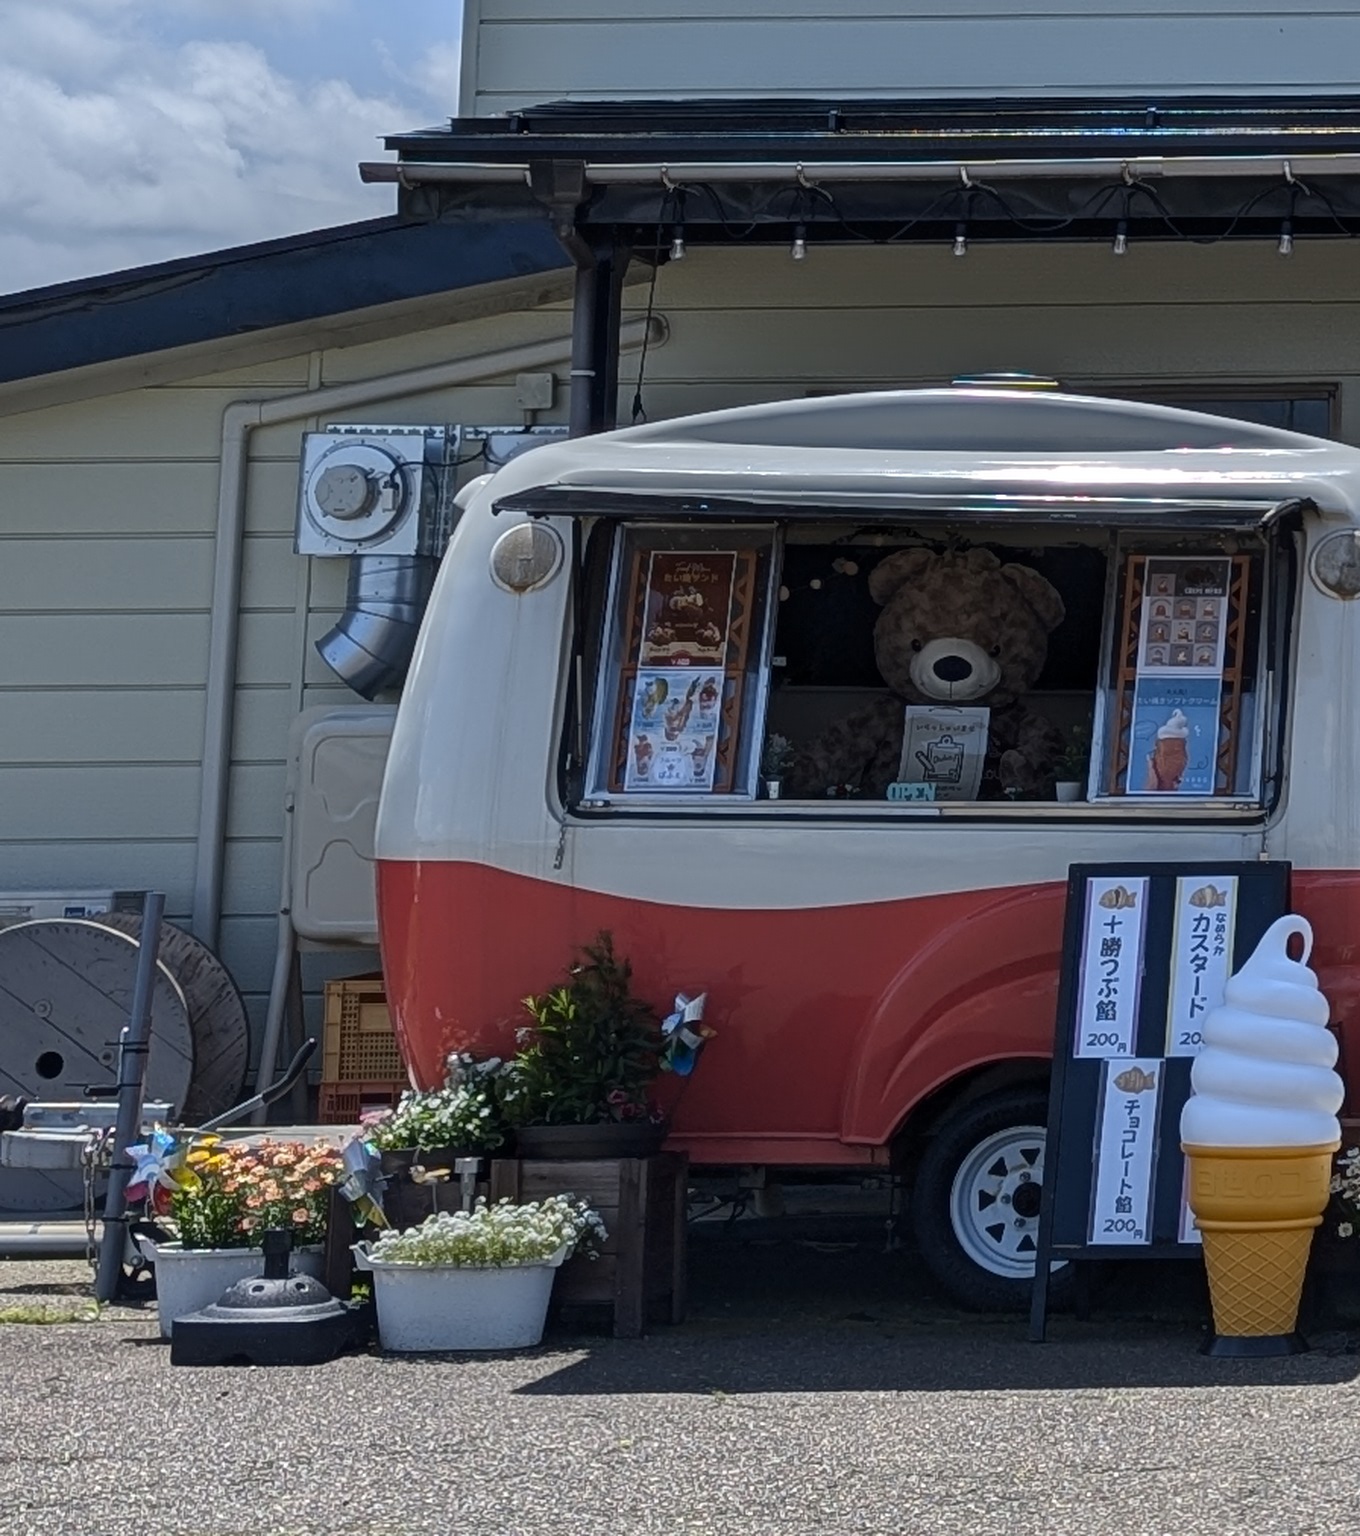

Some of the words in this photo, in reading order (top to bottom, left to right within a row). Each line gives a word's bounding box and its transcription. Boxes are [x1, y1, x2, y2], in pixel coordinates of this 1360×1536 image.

[1212, 912, 1228, 956] なめらか
[1095, 915, 1124, 1022] 十勝つぶ餡
[1189, 913, 1211, 1019] カスタード
[1086, 1032, 1127, 1053] 200円
[1179, 1031, 1206, 1046] 20
[1115, 1099, 1141, 1214] チョコレート餡
[1103, 1219, 1144, 1240] 200円
